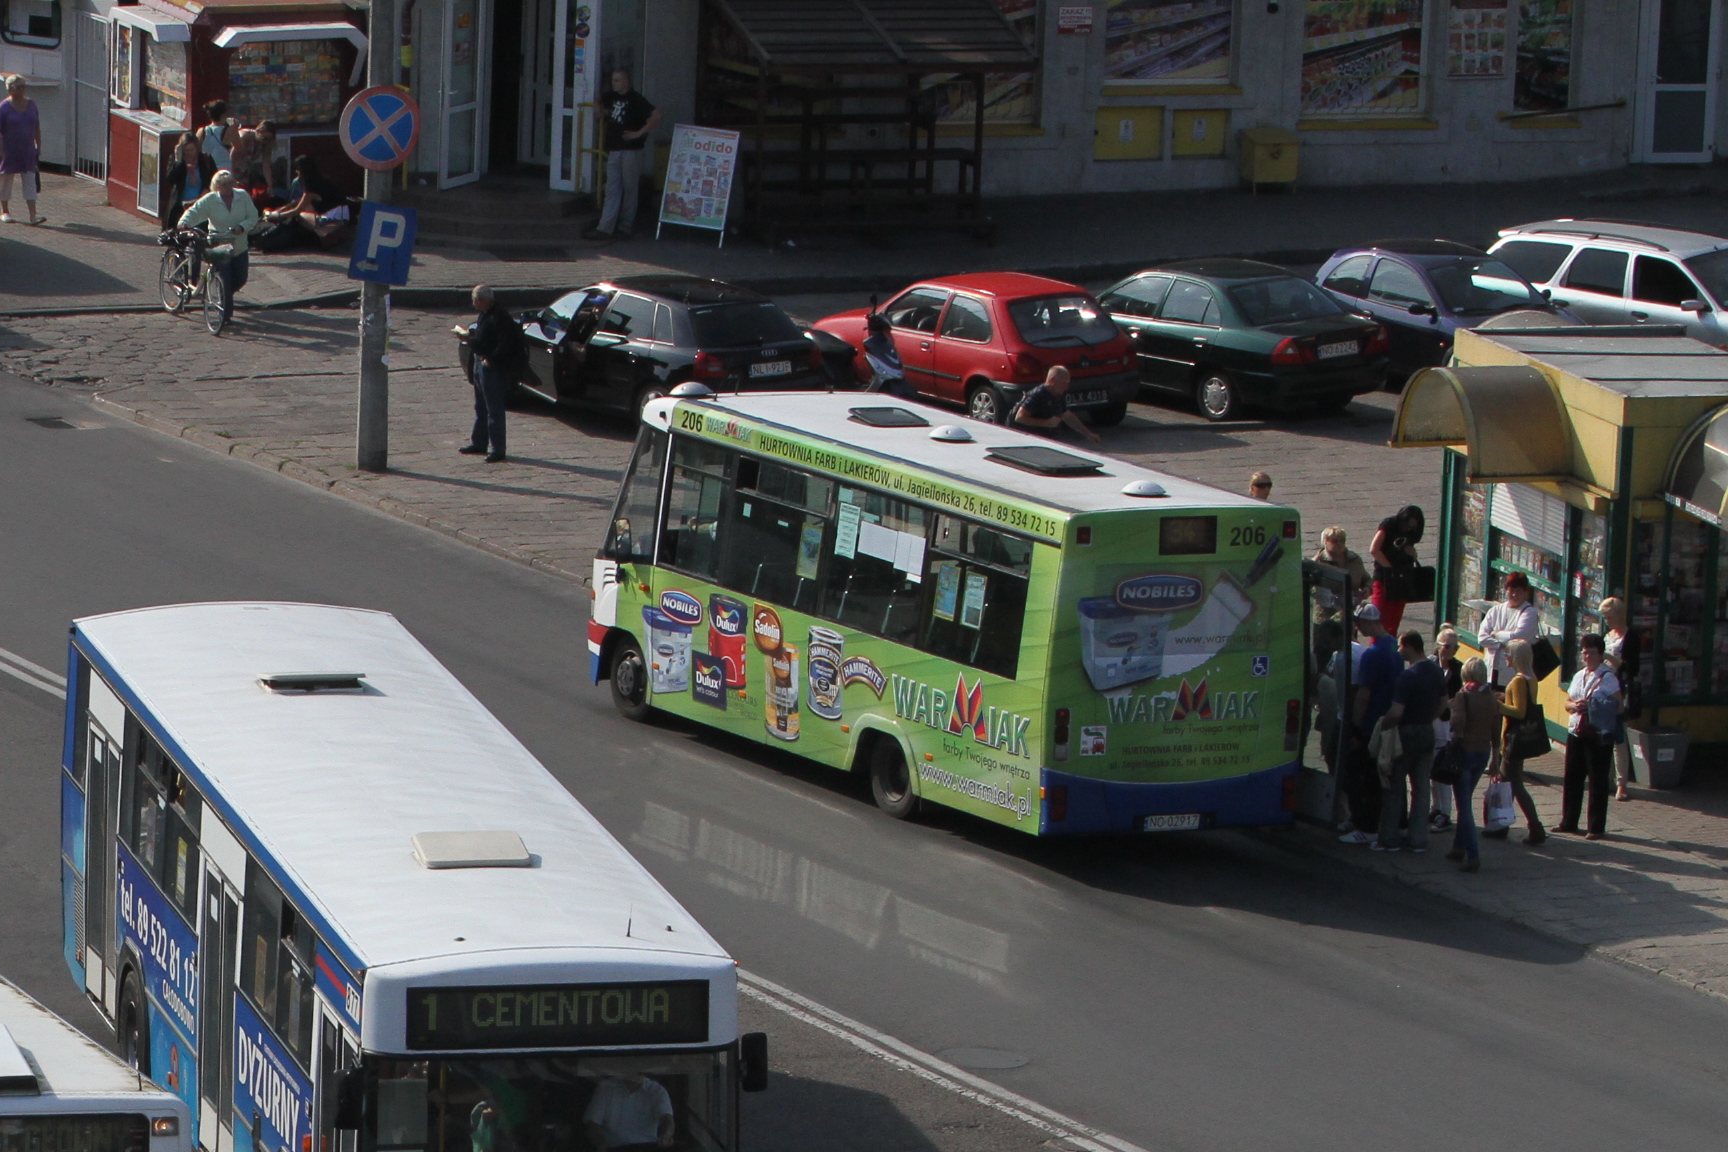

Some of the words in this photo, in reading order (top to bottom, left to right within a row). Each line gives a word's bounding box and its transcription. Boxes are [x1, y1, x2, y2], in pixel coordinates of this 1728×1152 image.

[366, 210, 406, 258] P
[681, 409, 704, 433] 206
[760, 436, 812, 464] HURTOWNIA
[815, 451, 836, 469] FARB
[844, 459, 891, 488] LAKIERÓW,
[893, 474, 905, 491] ul.
[906, 479, 961, 508] Jagiellońska
[964, 494, 977, 515] 26,
[979, 500, 994, 518] tel.
[996, 505, 1009, 522] 89
[1010, 508, 1028, 527] 534
[1031, 514, 1042, 532] 72
[1045, 519, 1056, 536] 15
[1230, 525, 1265, 546] 206
[663, 597, 699, 617] NOBILES
[1122, 584, 1196, 600] NOBILES
[716, 614, 738, 633] Dulux
[754, 619, 780, 640] Sadolin
[696, 670, 721, 690] Dulux
[843, 661, 883, 688] HAMMERITE
[891, 672, 1031, 759] WARMIAK
[1105, 677, 1260, 724] WARMIAK
[943, 738, 963, 761] farby
[966, 746, 997, 772] Twojego
[999, 758, 1031, 780] wnętrza
[918, 762, 1032, 820] www.warmiak.pl
[1150, 816, 1165, 827] NO
[1168, 815, 1198, 827] 02917
[121, 878, 135, 931] tel.
[137, 897, 148, 946] 89
[150, 913, 167, 972] 522
[169, 938, 180, 988] 81
[184, 956, 195, 1007] 12
[347, 985, 359, 1024] 877
[422, 993, 438, 1031] 1
[471, 988, 671, 1028] CEMENTOWA
